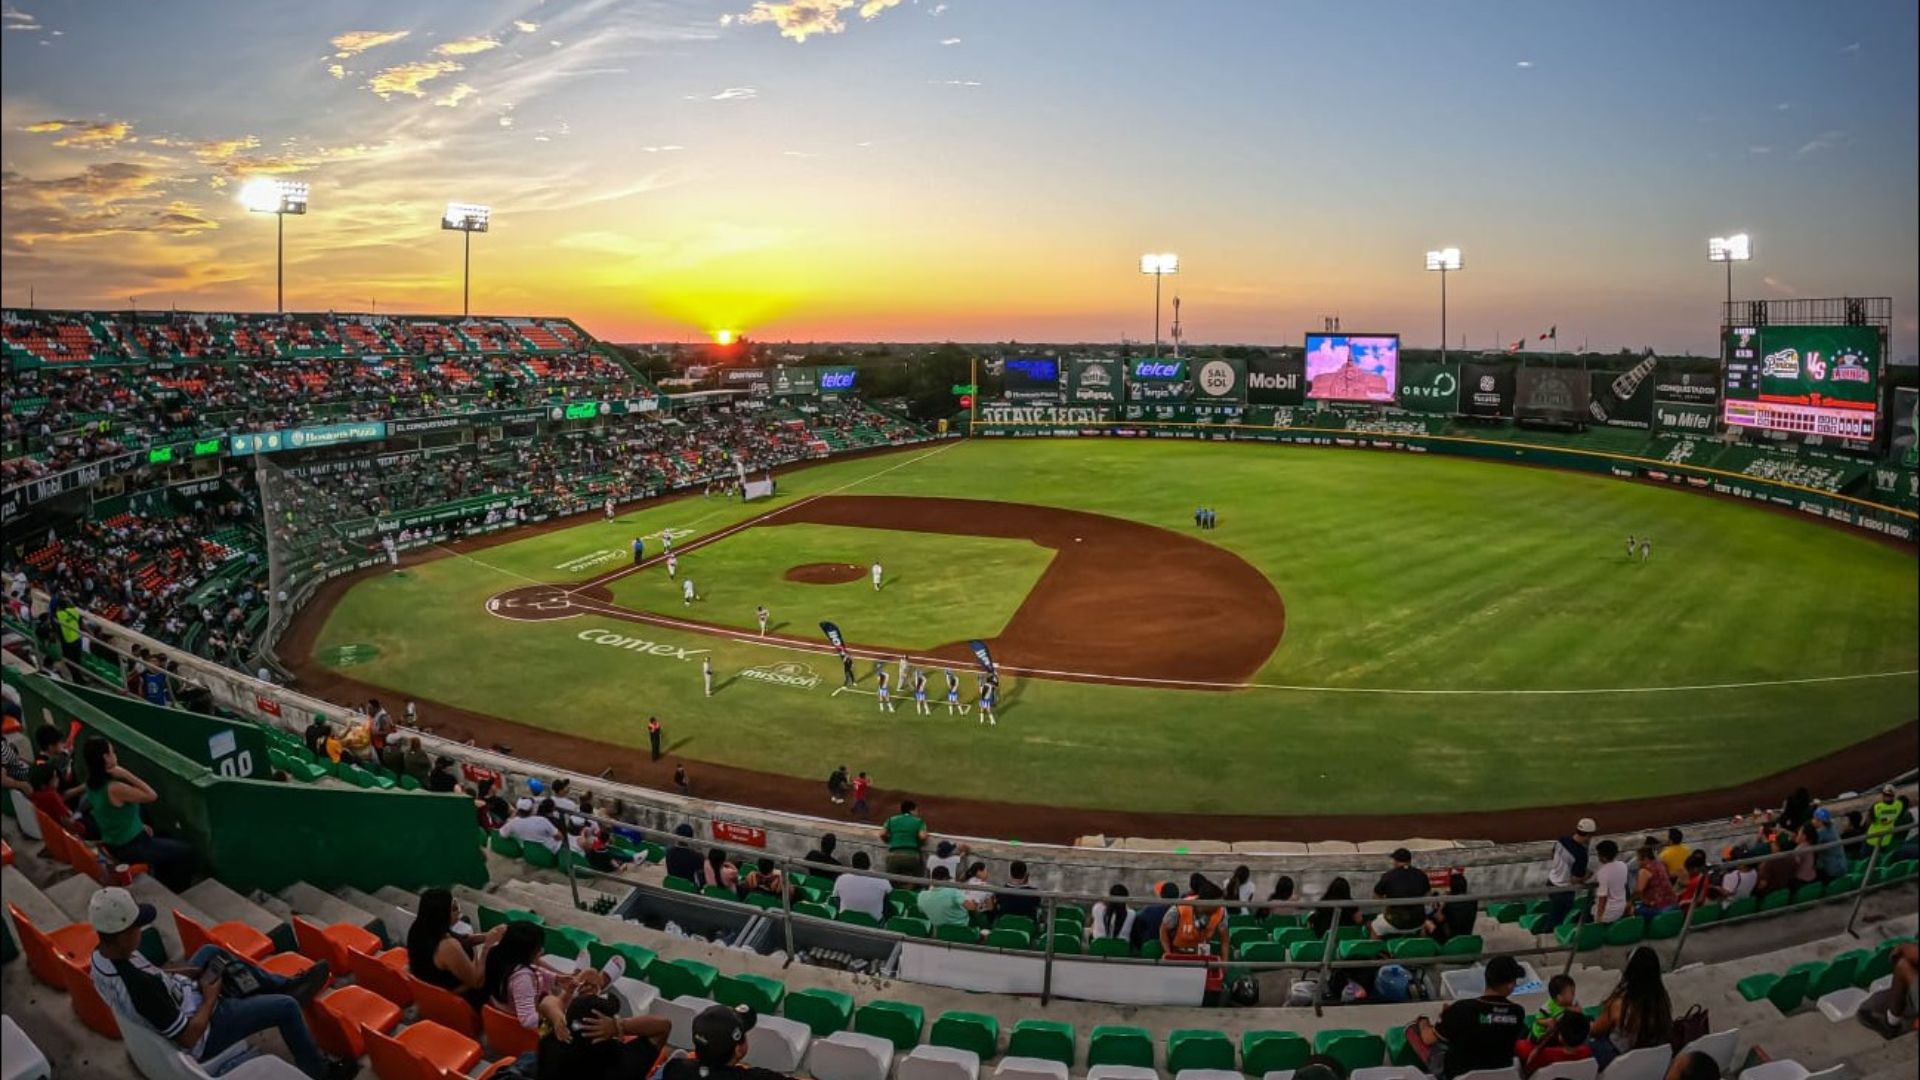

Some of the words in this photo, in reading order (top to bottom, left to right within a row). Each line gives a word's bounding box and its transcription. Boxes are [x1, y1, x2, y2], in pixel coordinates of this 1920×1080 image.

[1135, 361, 1181, 377] telcel
[1208, 369, 1227, 378] SAL
[821, 371, 857, 389] telcel
[1207, 378, 1227, 387] SOL
[1249, 372, 1298, 389] Mobil
[1678, 411, 1711, 429] Mifel
[577, 628, 713, 660] comex
[741, 668, 819, 689] mission
